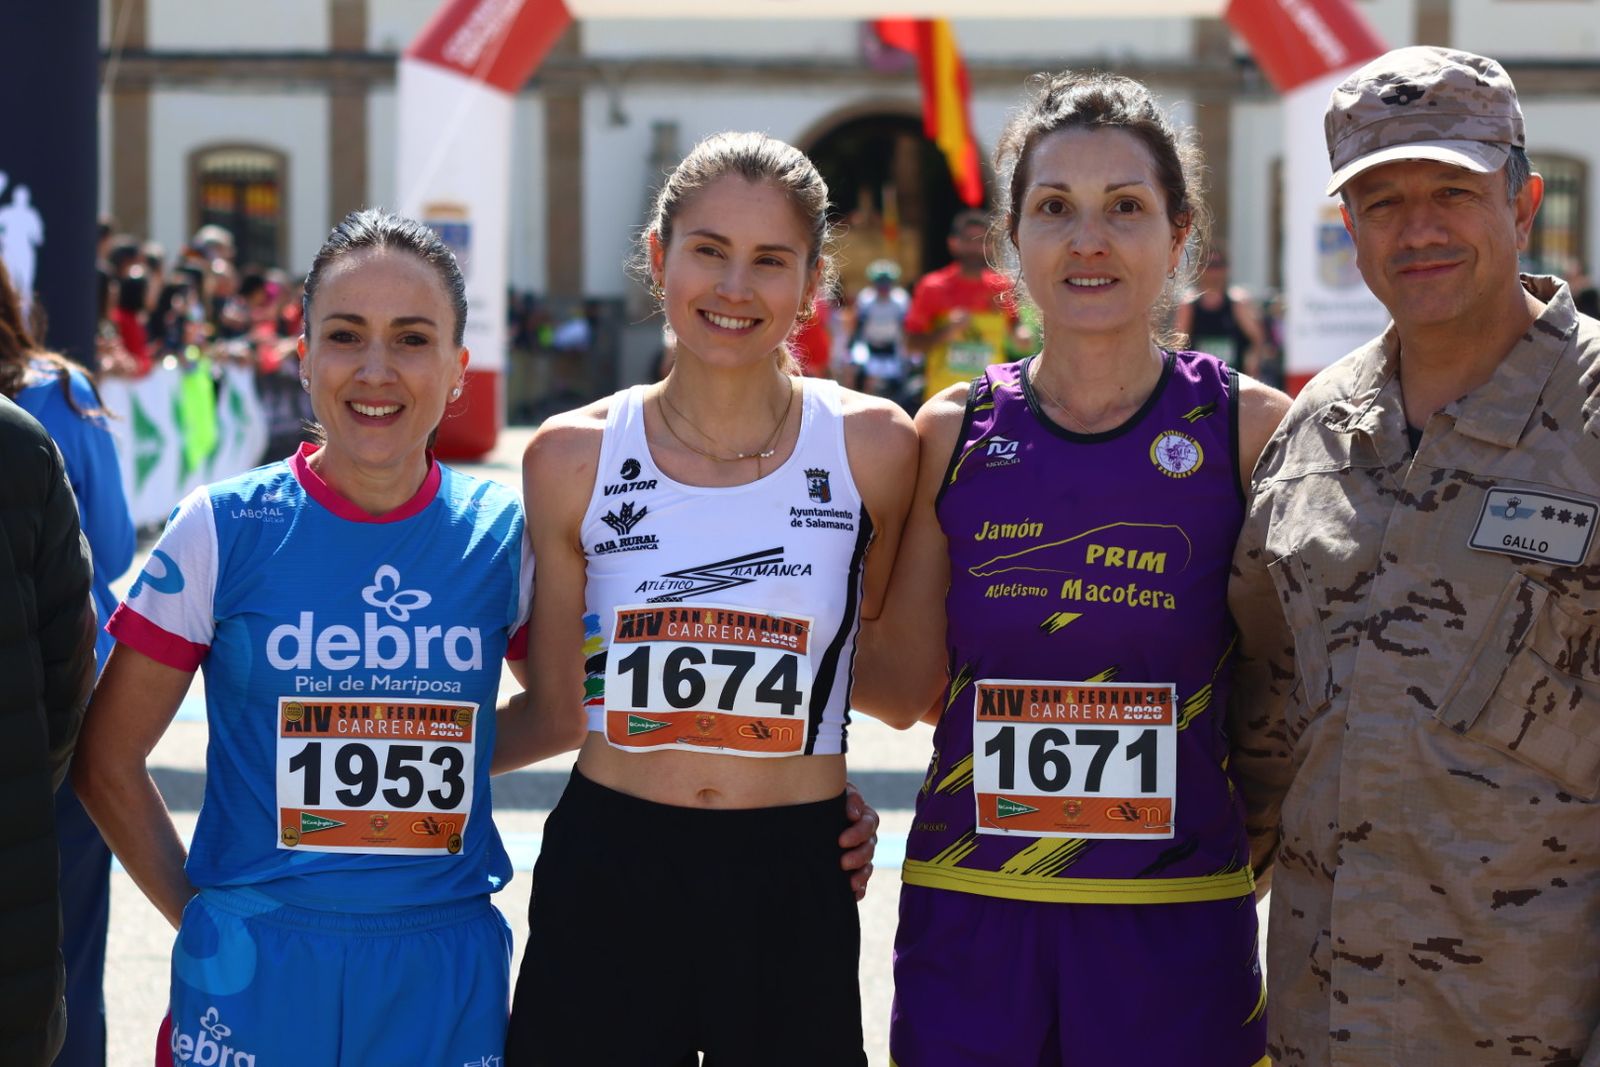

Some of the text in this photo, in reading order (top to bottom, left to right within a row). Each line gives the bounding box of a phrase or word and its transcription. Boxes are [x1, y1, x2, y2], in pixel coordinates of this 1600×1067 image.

[604, 479, 657, 496] VIATOR
[231, 507, 284, 519] LABORAL
[789, 506, 853, 520] Ayuntamiento
[790, 519, 854, 532] de Salamanca
[974, 517, 1044, 541] Jamón
[619, 535, 659, 548] RURAL
[1502, 534, 1549, 553] GALLO
[1085, 544, 1167, 574] PRIM
[634, 579, 694, 594] ATLÉTICO
[984, 579, 1176, 610] Atletismo Macotera
[619, 610, 803, 638] XIV SAN FERNANDO
[667, 623, 756, 641] CARRERA
[266, 611, 483, 672] debra
[295, 675, 462, 695] Piel de Mariposa
[618, 646, 803, 715] 1674
[980, 688, 1025, 716] XIV
[1030, 690, 1063, 704] SAN
[1029, 703, 1119, 720] CARRERA
[338, 705, 370, 719] SAN
[337, 719, 426, 736] CARRERA
[985, 726, 1158, 793] 1671
[289, 742, 465, 810] 1953
